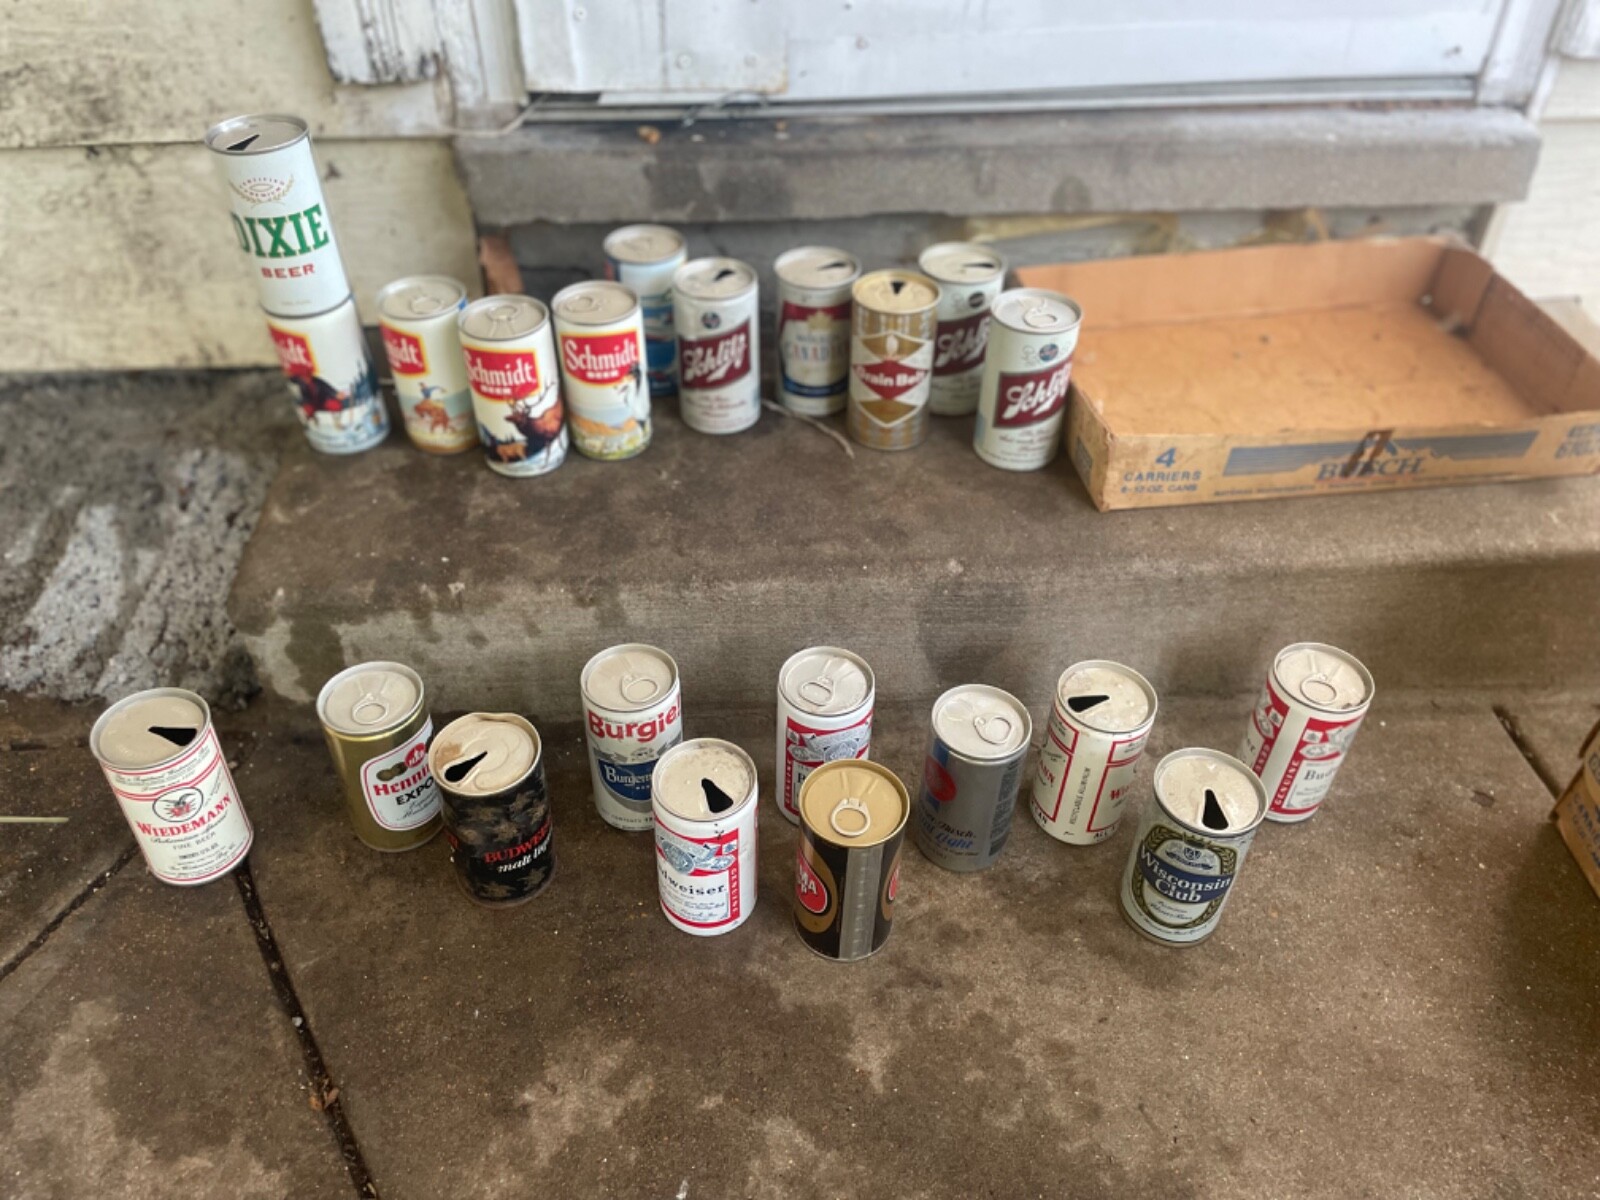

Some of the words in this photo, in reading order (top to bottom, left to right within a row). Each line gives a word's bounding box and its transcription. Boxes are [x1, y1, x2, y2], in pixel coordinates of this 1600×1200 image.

[229, 203, 329, 258] DIXIE
[260, 263, 315, 279] BEER
[462, 348, 532, 388] Schmidt
[564, 337, 638, 373] Schmidt
[1155, 447, 1176, 468] 4
[1123, 470, 1201, 482] CARRIERS
[587, 695, 680, 742] Burgie!
[373, 763, 430, 796] Henni
[396, 776, 434, 806] EXPO
[136, 794, 233, 838] WIEDEMANN
[1139, 844, 1232, 893] Wisconsin
[1154, 877, 1202, 903] Club
